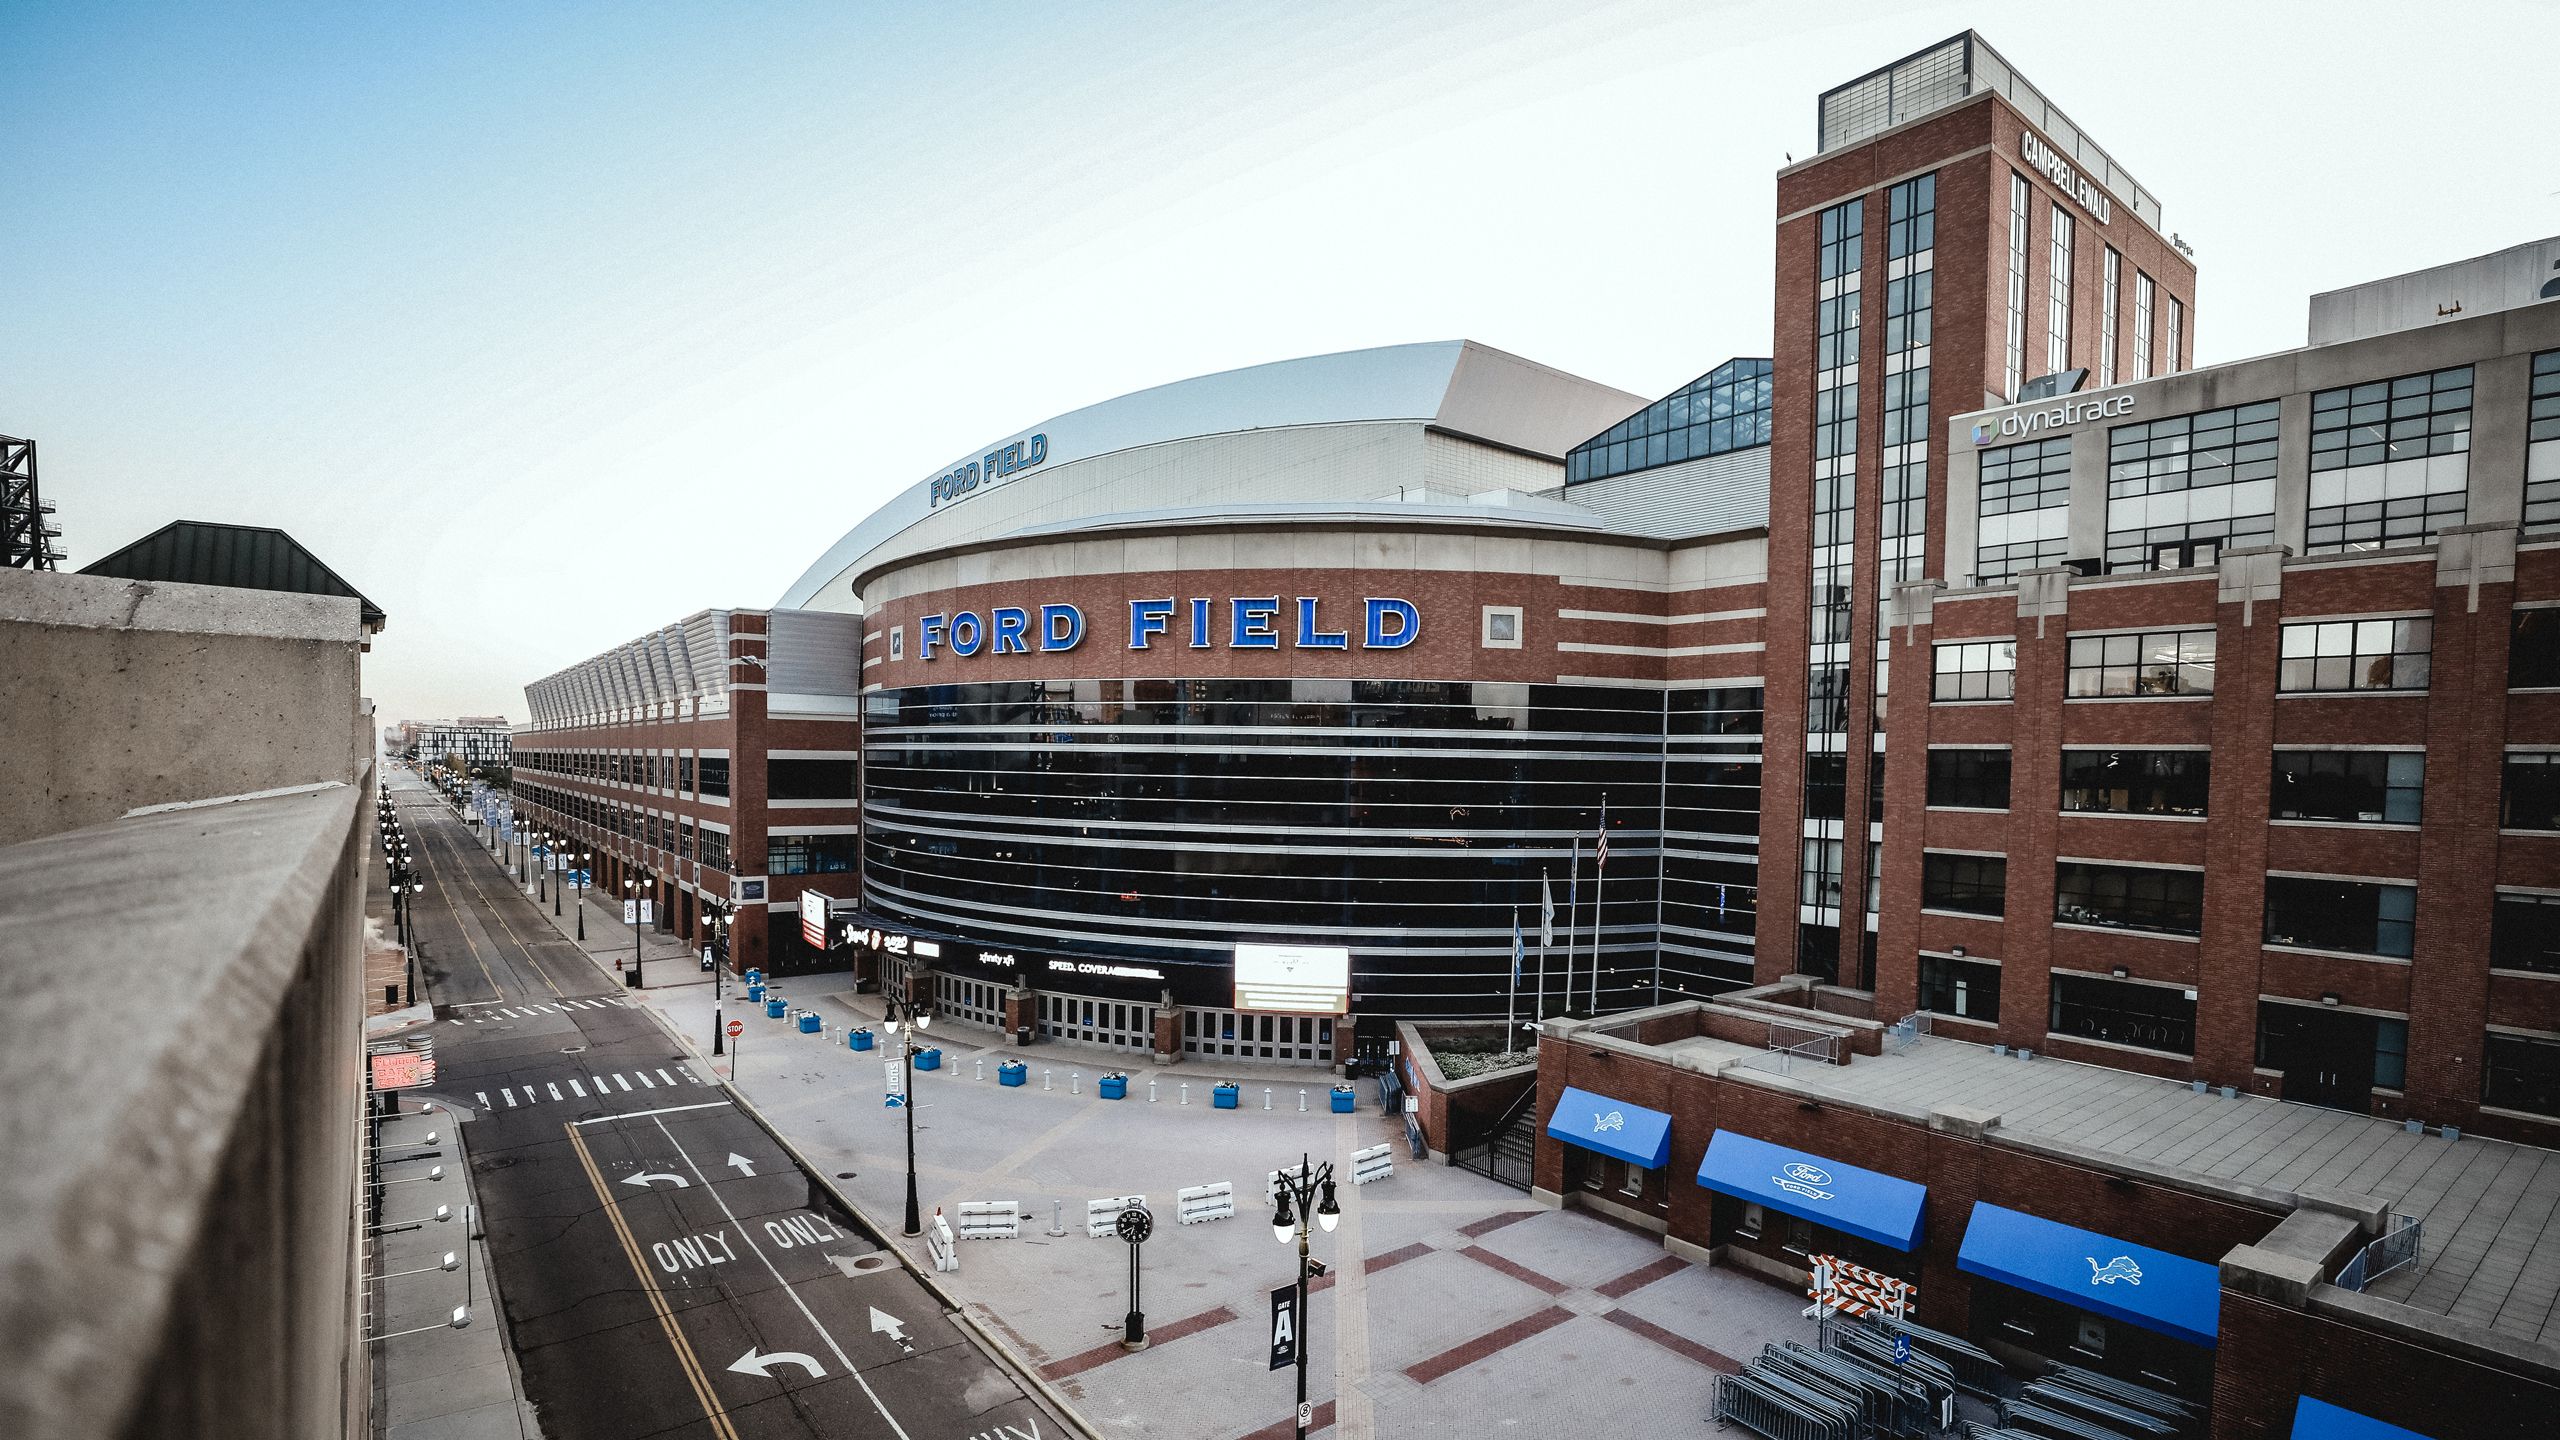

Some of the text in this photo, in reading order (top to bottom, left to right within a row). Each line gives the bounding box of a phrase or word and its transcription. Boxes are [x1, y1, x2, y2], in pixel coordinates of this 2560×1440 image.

[2021, 130, 2110, 226] CAMPBELL EWALD
[2001, 394, 2135, 438] dynatrace
[930, 432, 1048, 508] FORD FIELD
[919, 595, 1421, 660] FORD FIELD
[727, 1024, 743, 1033] STOP
[1792, 1165, 1823, 1183] Ford
[764, 1213, 844, 1249] ONLY
[652, 1230, 737, 1273] ONLY
[1277, 1300, 1291, 1311] GATE
[1273, 1309, 1294, 1347] A
